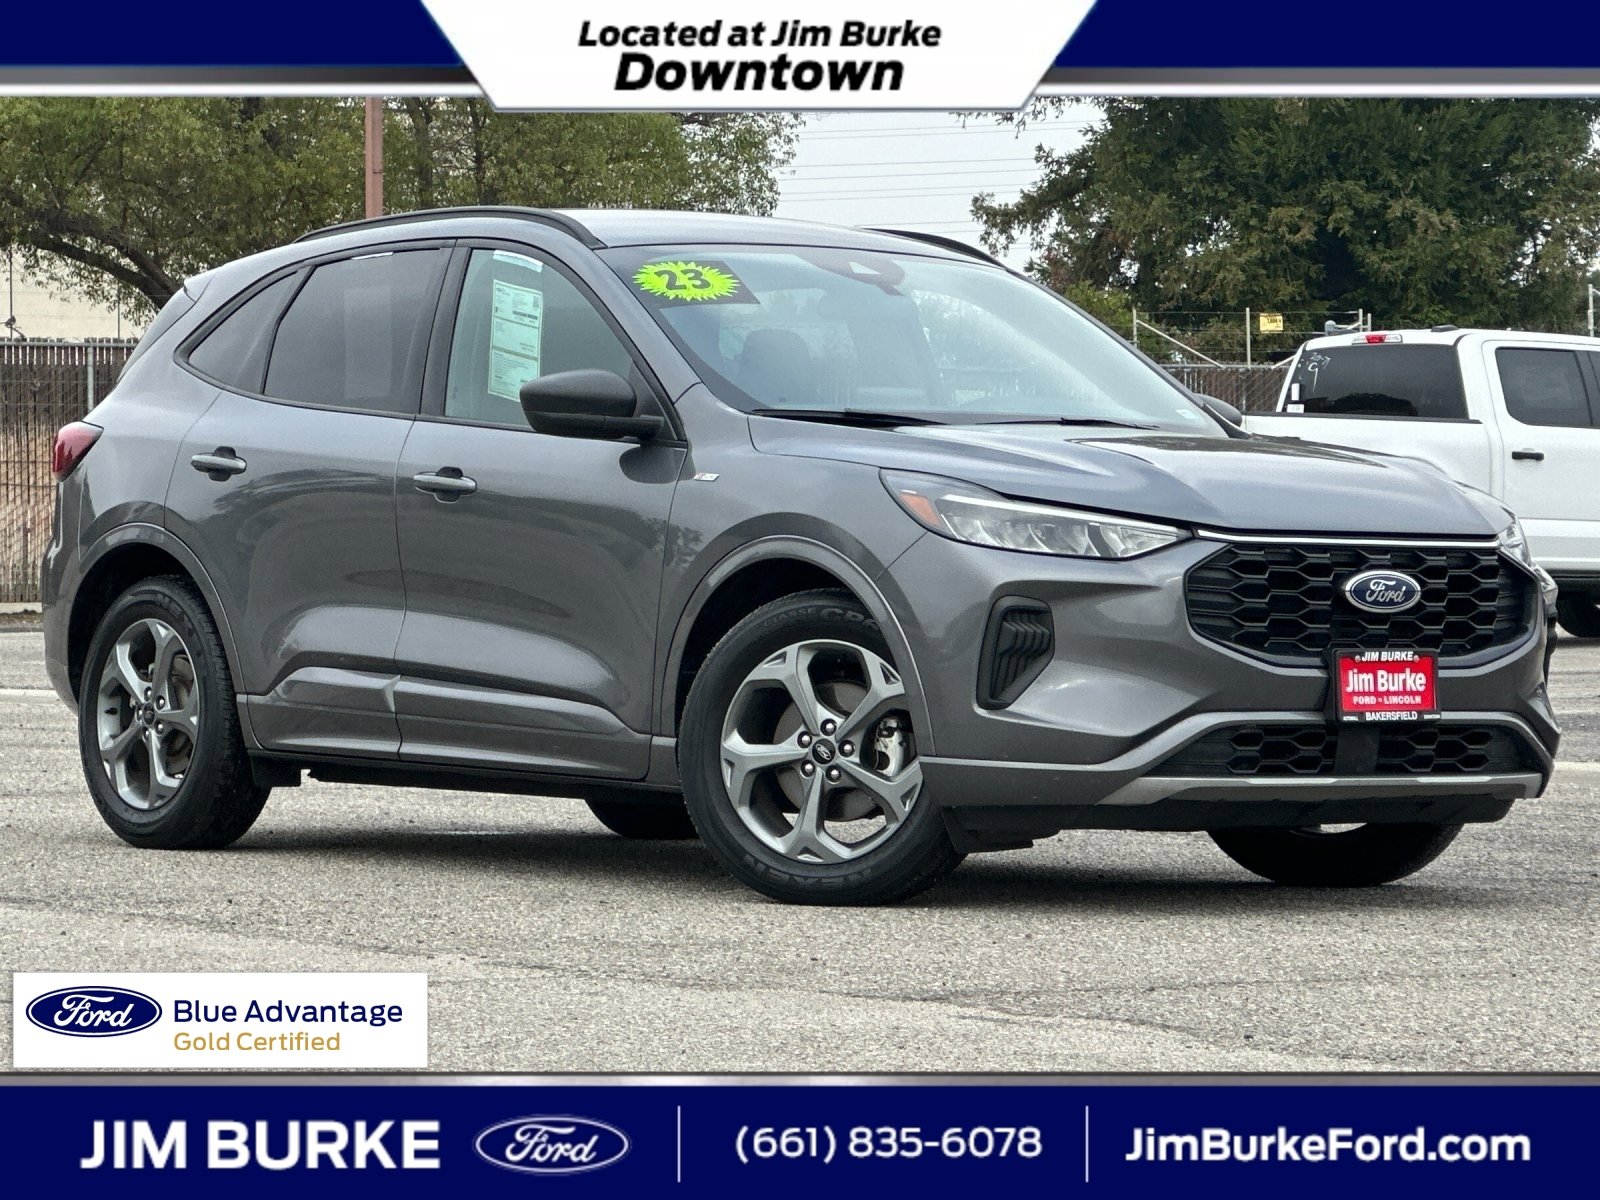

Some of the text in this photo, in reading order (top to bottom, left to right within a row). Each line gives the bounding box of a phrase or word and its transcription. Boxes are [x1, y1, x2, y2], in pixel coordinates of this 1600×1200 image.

[653, 268, 712, 291] 23
[1365, 579, 1407, 602] Ford
[1361, 651, 1414, 662] JIM BURKE
[1346, 667, 1427, 692] Jim Burke
[1353, 695, 1377, 705] FORD
[1383, 694, 1422, 705] LINCOLN
[1365, 711, 1418, 721] BAKERSFIELD
